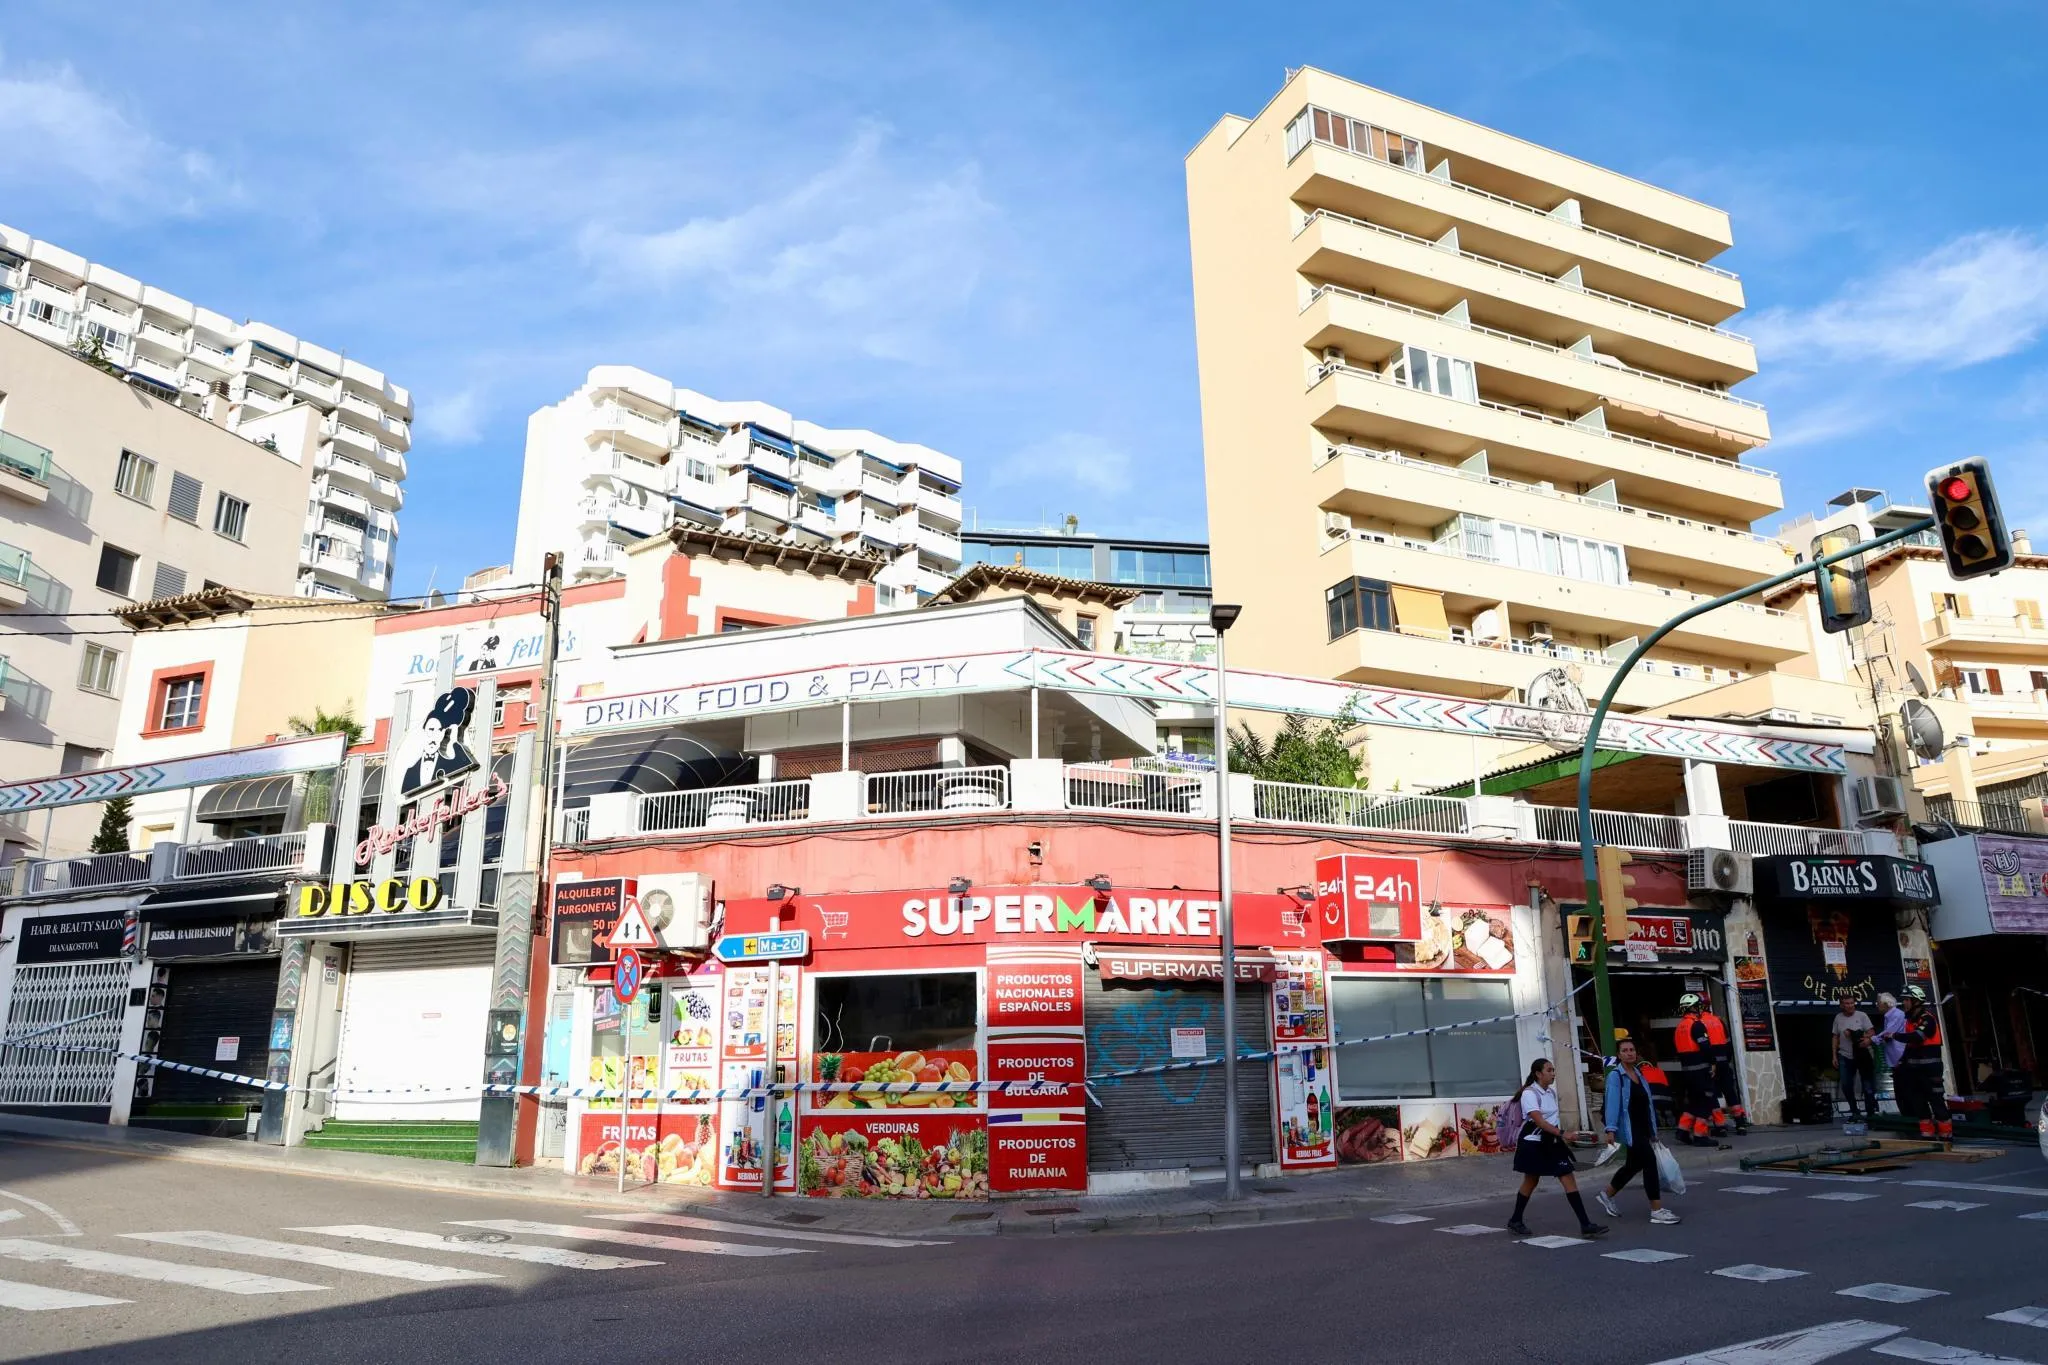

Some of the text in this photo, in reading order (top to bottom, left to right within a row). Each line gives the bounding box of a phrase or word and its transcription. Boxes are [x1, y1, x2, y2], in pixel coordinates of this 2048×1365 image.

[585, 661, 968, 726] DRINK FOOD & PARTY
[557, 886, 616, 900] ALQUILER DE
[1353, 874, 1413, 902] 24h
[1812, 886, 1861, 895] PIZZERIA BAR
[299, 876, 440, 917] DISCO
[557, 901, 617, 915] FURGONETAS
[30, 918, 125, 936] HAIR & BEAUTY SALON
[593, 919, 605, 930] 50
[151, 926, 234, 941] AISSA BARBERSHOP
[760, 938, 799, 952] Ma-20
[1111, 961, 1264, 978] SUPERMARET
[997, 974, 1073, 985] PRODUCTOS
[996, 988, 1074, 999] NACIONALES
[999, 1000, 1071, 1012] ESPAÑOLES
[674, 1053, 708, 1062] FRUTAS
[998, 1057, 1074, 1068] PRODUCTOS
[1028, 1071, 1045, 1081] DE
[1005, 1086, 1069, 1096] BULGARIA
[865, 1122, 920, 1134] VERDURAS
[998, 1138, 1076, 1149] PRODUCTOS
[1029, 1153, 1046, 1164] DE
[1009, 1167, 1067, 1178] RUMANIA
